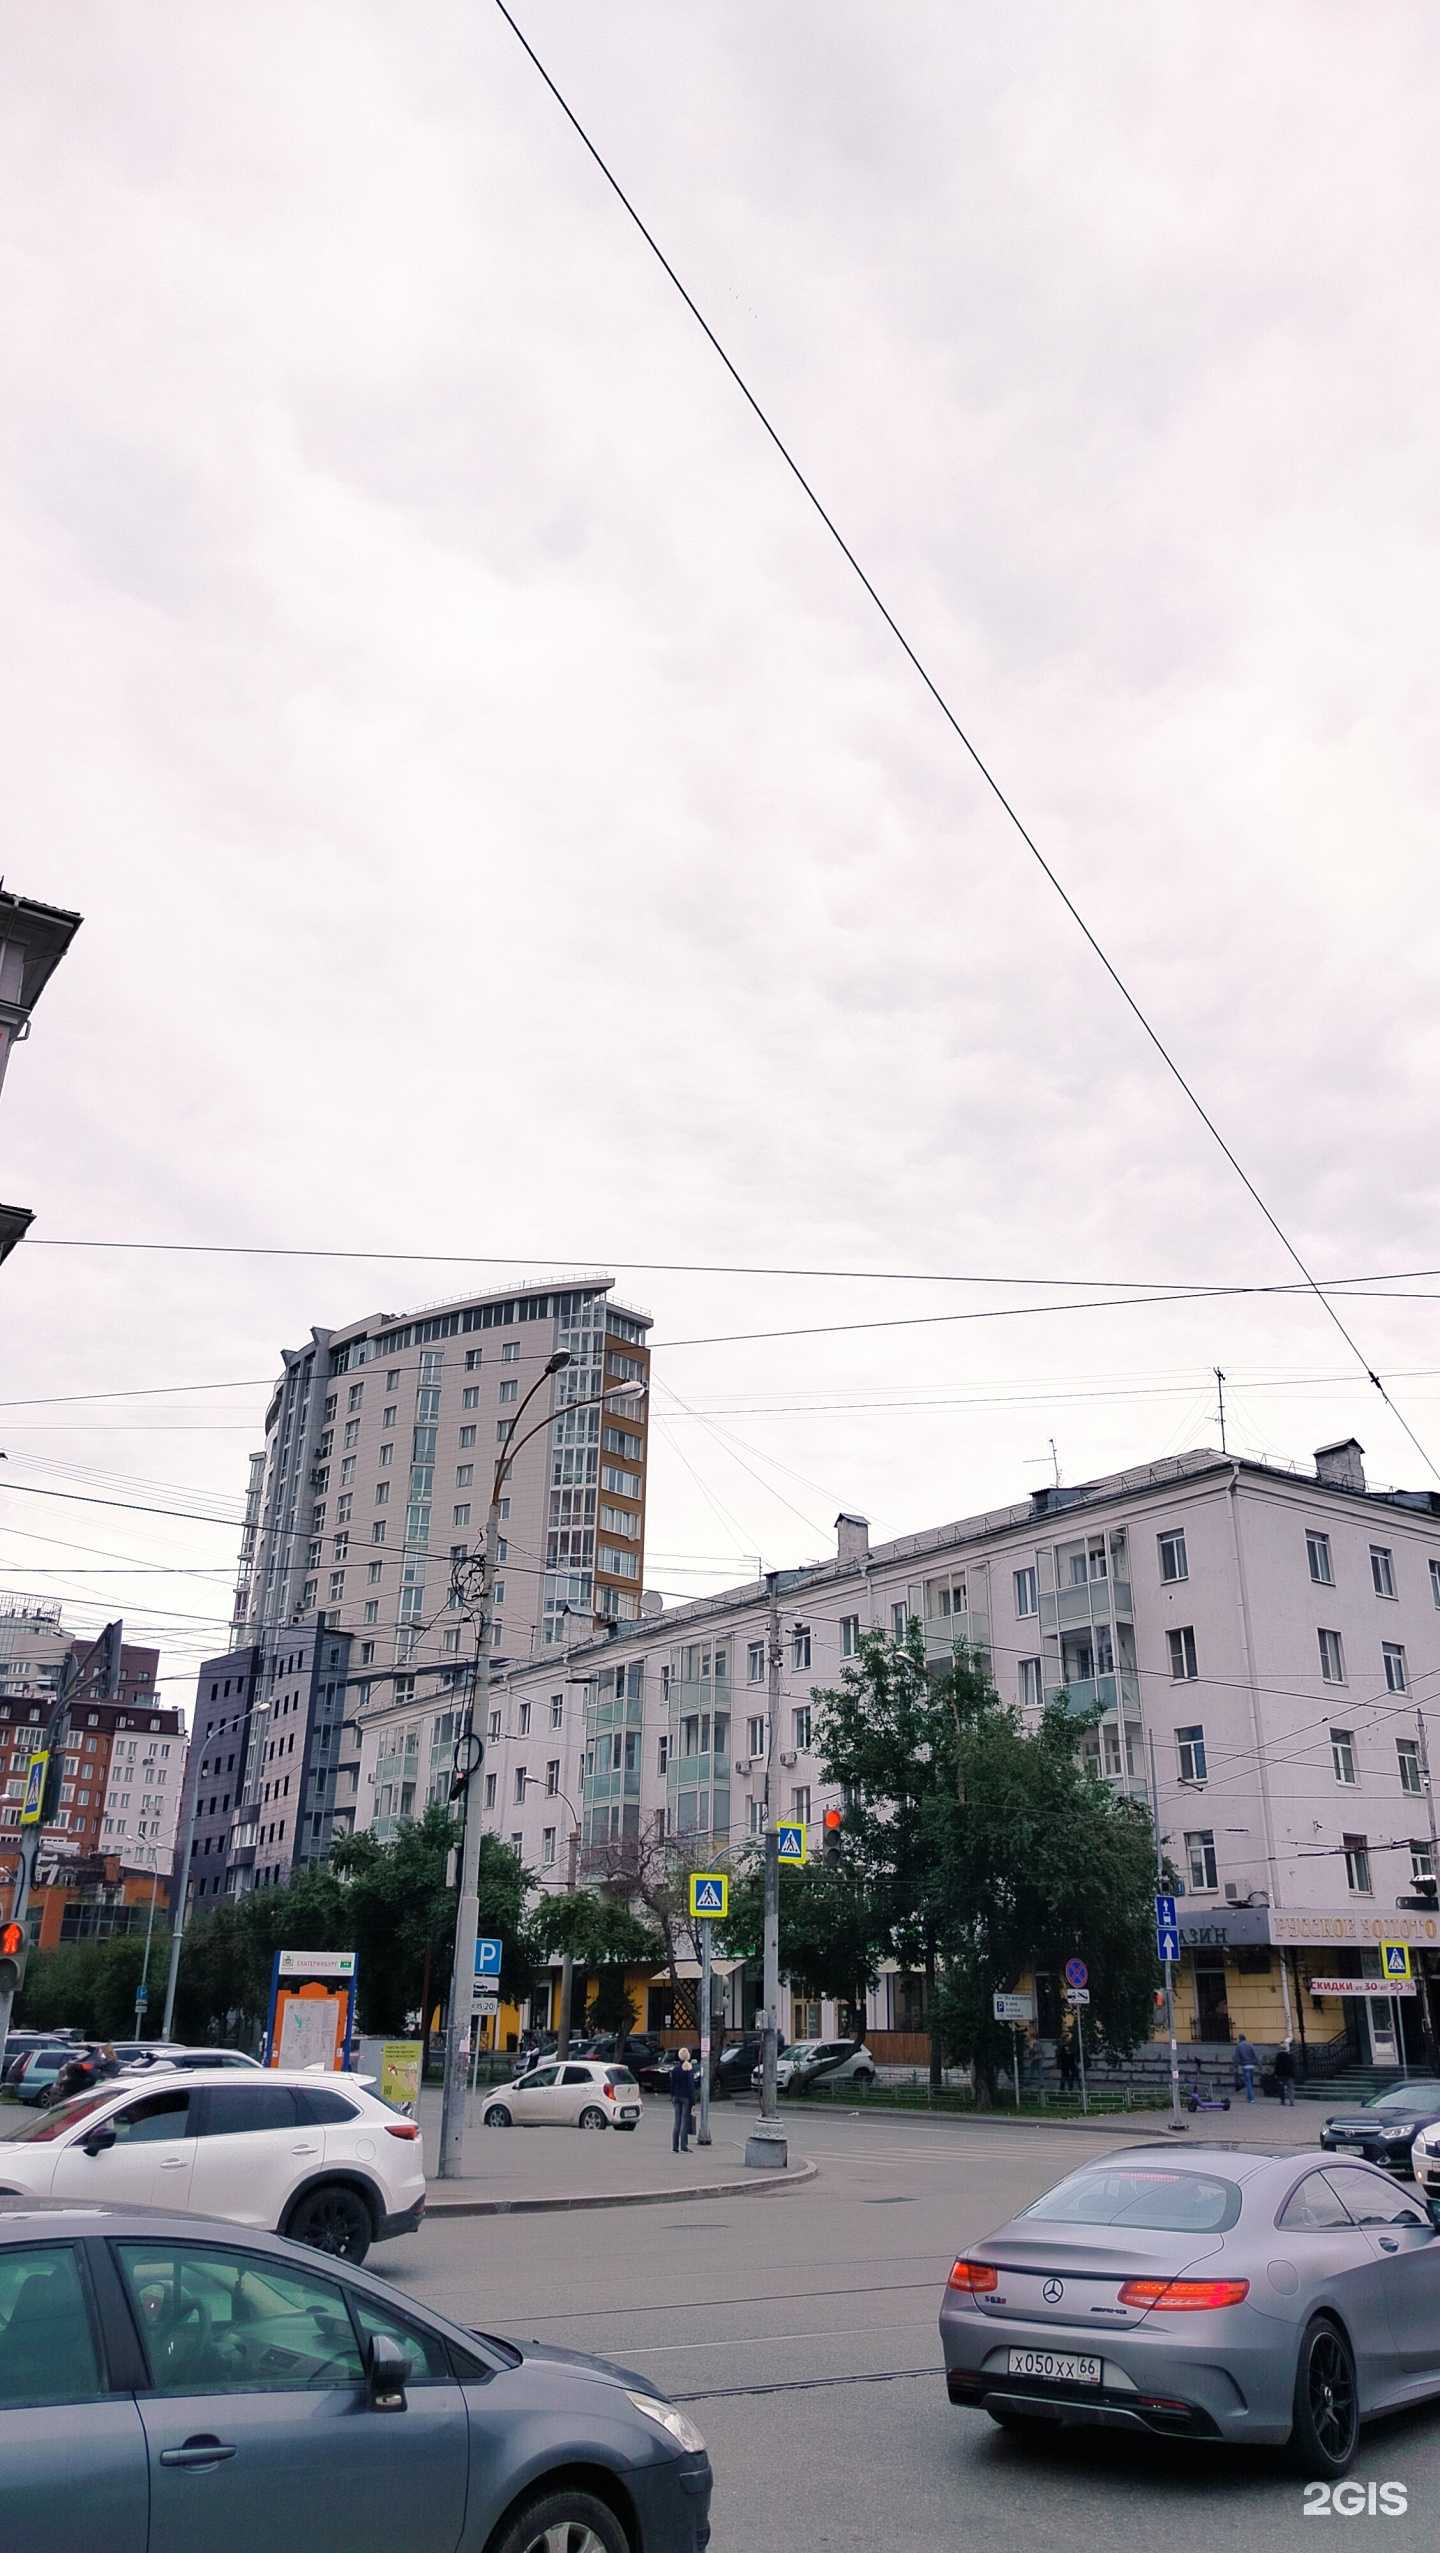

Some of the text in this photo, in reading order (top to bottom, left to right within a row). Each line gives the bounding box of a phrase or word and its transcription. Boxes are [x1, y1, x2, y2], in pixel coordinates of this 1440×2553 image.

[480, 1943, 496, 1969] P
[1311, 1981, 1353, 1991] СКИДКИ
[1364, 1982, 1378, 1991] 30
[1079, 2359, 1095, 2375] 66
